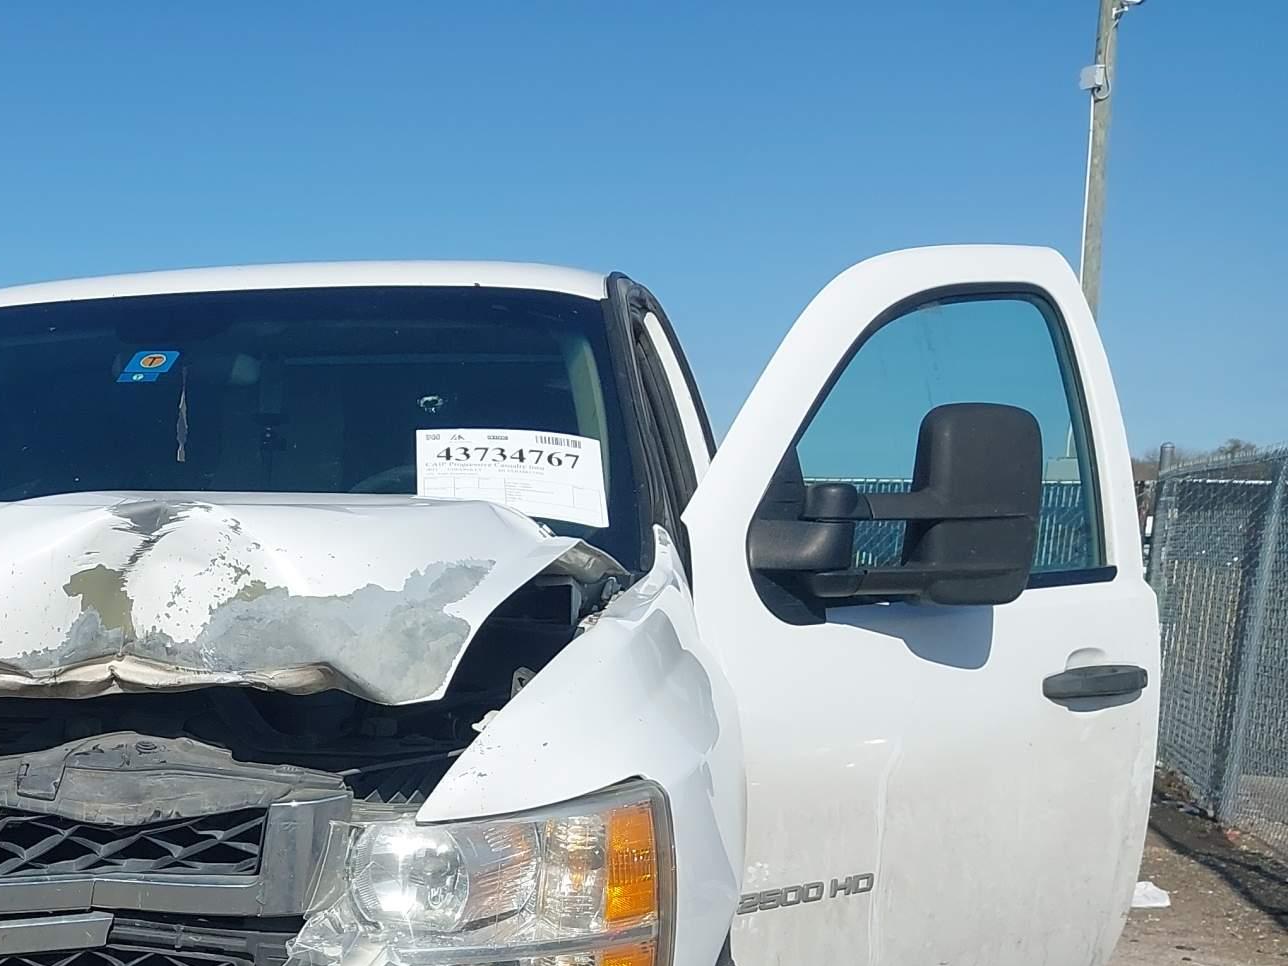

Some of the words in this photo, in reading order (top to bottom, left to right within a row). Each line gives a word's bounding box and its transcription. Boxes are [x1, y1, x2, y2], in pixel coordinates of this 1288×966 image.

[436, 446, 580, 470] 43734767
[736, 881, 825, 915] 2500
[829, 872, 875, 899] HD
